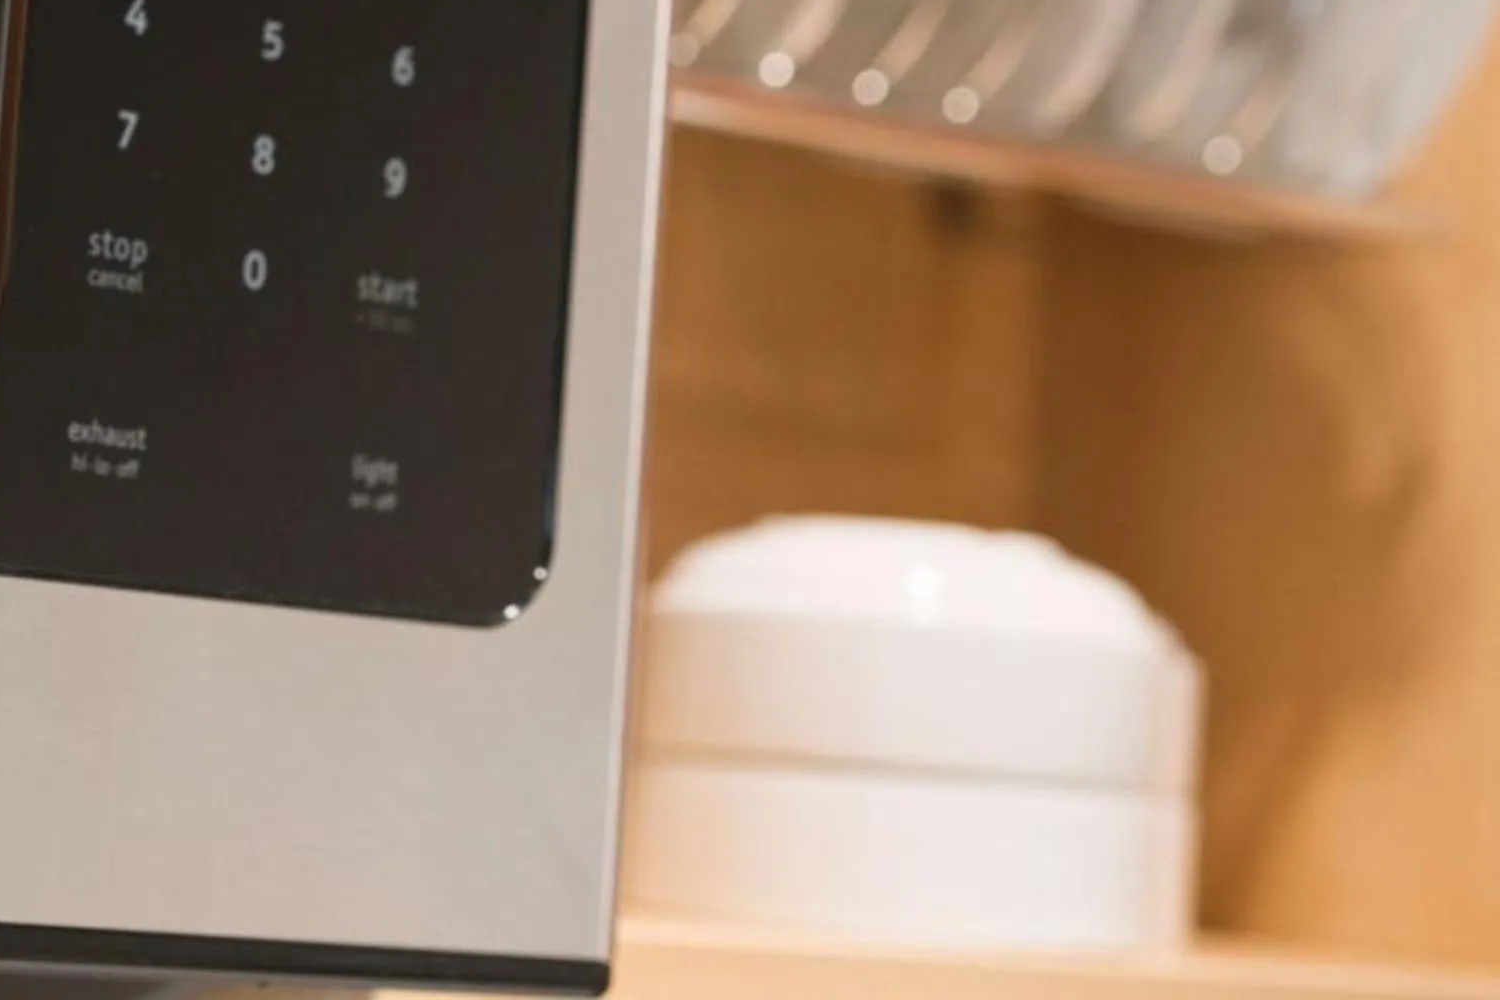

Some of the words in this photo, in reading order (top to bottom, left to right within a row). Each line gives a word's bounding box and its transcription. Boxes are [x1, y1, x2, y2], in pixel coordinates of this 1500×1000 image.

[261, 19, 284, 60] 5
[392, 46, 415, 86] 6
[118, 110, 139, 149] 7
[251, 134, 275, 176] 8
[383, 157, 407, 198] 9
[88, 230, 148, 268] stop
[87, 267, 144, 292] cancel
[242, 249, 268, 291] 0
[357, 271, 419, 309] start
[68, 417, 148, 451] exhaust
[352, 453, 398, 487] light
